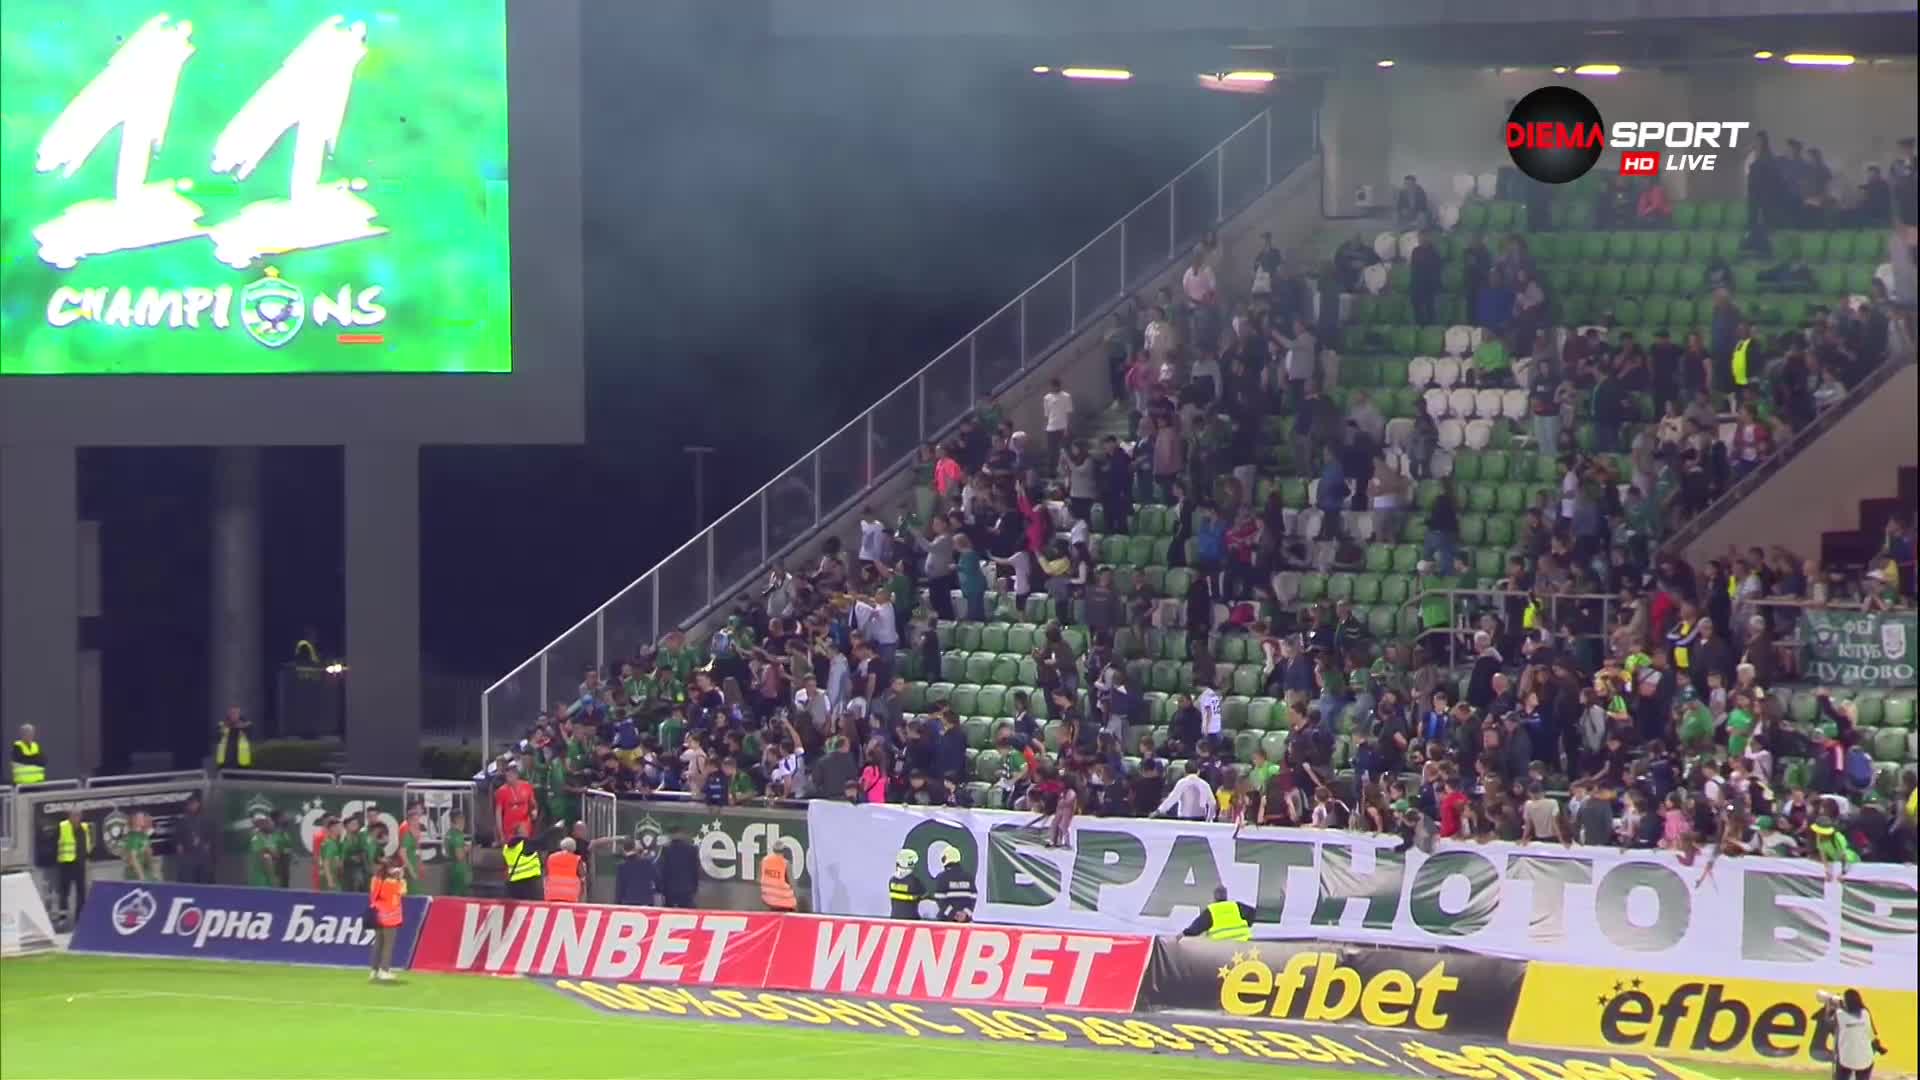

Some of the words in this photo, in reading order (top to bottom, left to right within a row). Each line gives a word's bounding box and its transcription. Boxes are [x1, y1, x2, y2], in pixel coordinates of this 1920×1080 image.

[32, 13, 389, 270] 11
[699, 823, 814, 880] efb
[902, 818, 1692, 953] ОБРАТНОТО
[161, 897, 273, 948] Горна
[456, 903, 748, 983] WINBET
[809, 921, 1114, 1007] WINBET
[1220, 951, 1459, 1031] efbet
[712, 990, 965, 1037] БОНУС
[1172, 1023, 1390, 1068] ЛЕВА
